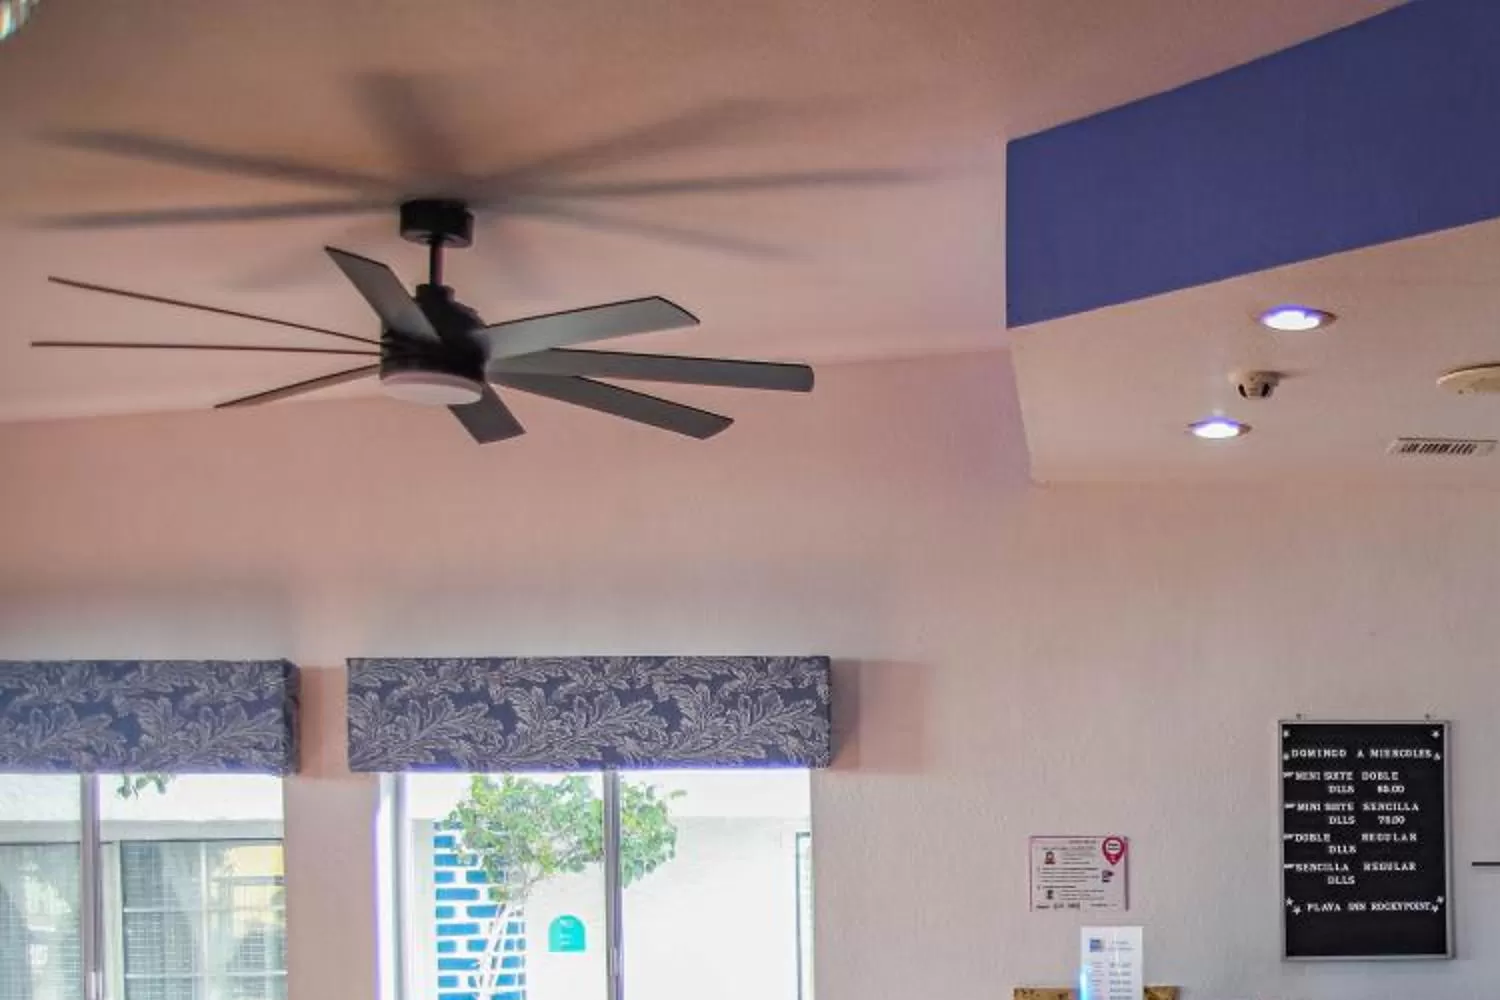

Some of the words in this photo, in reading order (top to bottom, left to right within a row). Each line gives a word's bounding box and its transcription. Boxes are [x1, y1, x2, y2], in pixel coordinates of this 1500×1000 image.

[1357, 749, 1364, 759] A
[1361, 771, 1399, 781] DOBLE
[1296, 802, 1321, 811] MINI
[1362, 802, 1419, 811] SENCILLA
[1328, 815, 1356, 825] DLLS
[1295, 833, 1331, 842] DOBLE
[1327, 875, 1355, 885] DLLS
[1307, 902, 1341, 912] PLAYA
